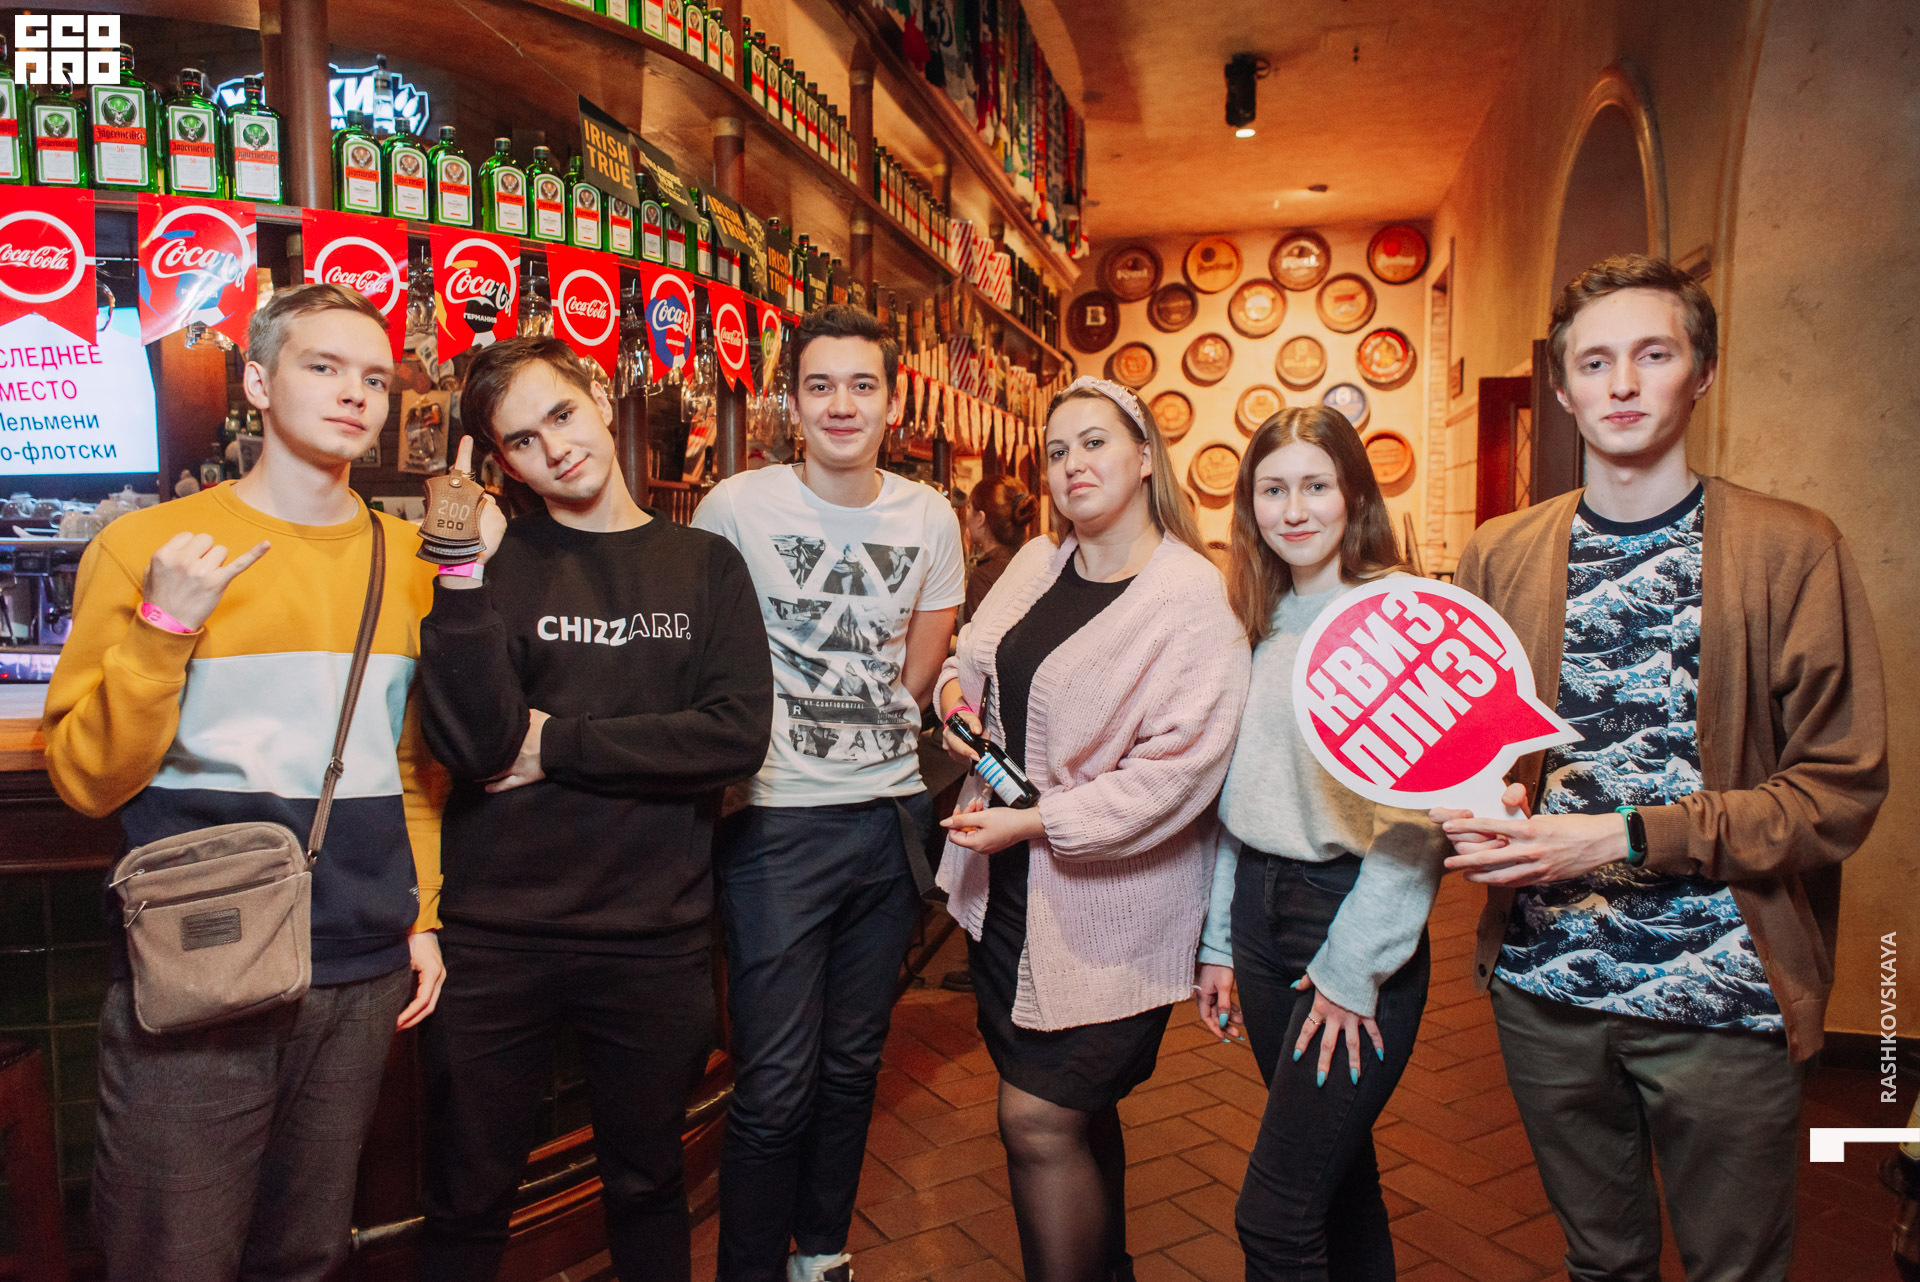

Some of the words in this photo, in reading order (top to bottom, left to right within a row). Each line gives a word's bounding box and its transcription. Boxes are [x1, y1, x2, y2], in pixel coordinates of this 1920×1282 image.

[584, 119, 631, 166] IRISH
[586, 144, 634, 190] TRUE
[706, 194, 746, 230] IRISH
[768, 246, 789, 273] IRISH
[463, 312, 498, 324] ГЕРМАНИЯ
[566, 295, 608, 320] Coca-Cola
[0, 379, 78, 402] МЕСТО
[437, 500, 470, 521] 200
[437, 519, 464, 531] 200
[1306, 590, 1460, 737] КВИЗ,
[792, 704, 802, 715] R
[816, 701, 865, 710] CONFIDENTIAL
[1339, 616, 1513, 789] ПЛИЗ!
